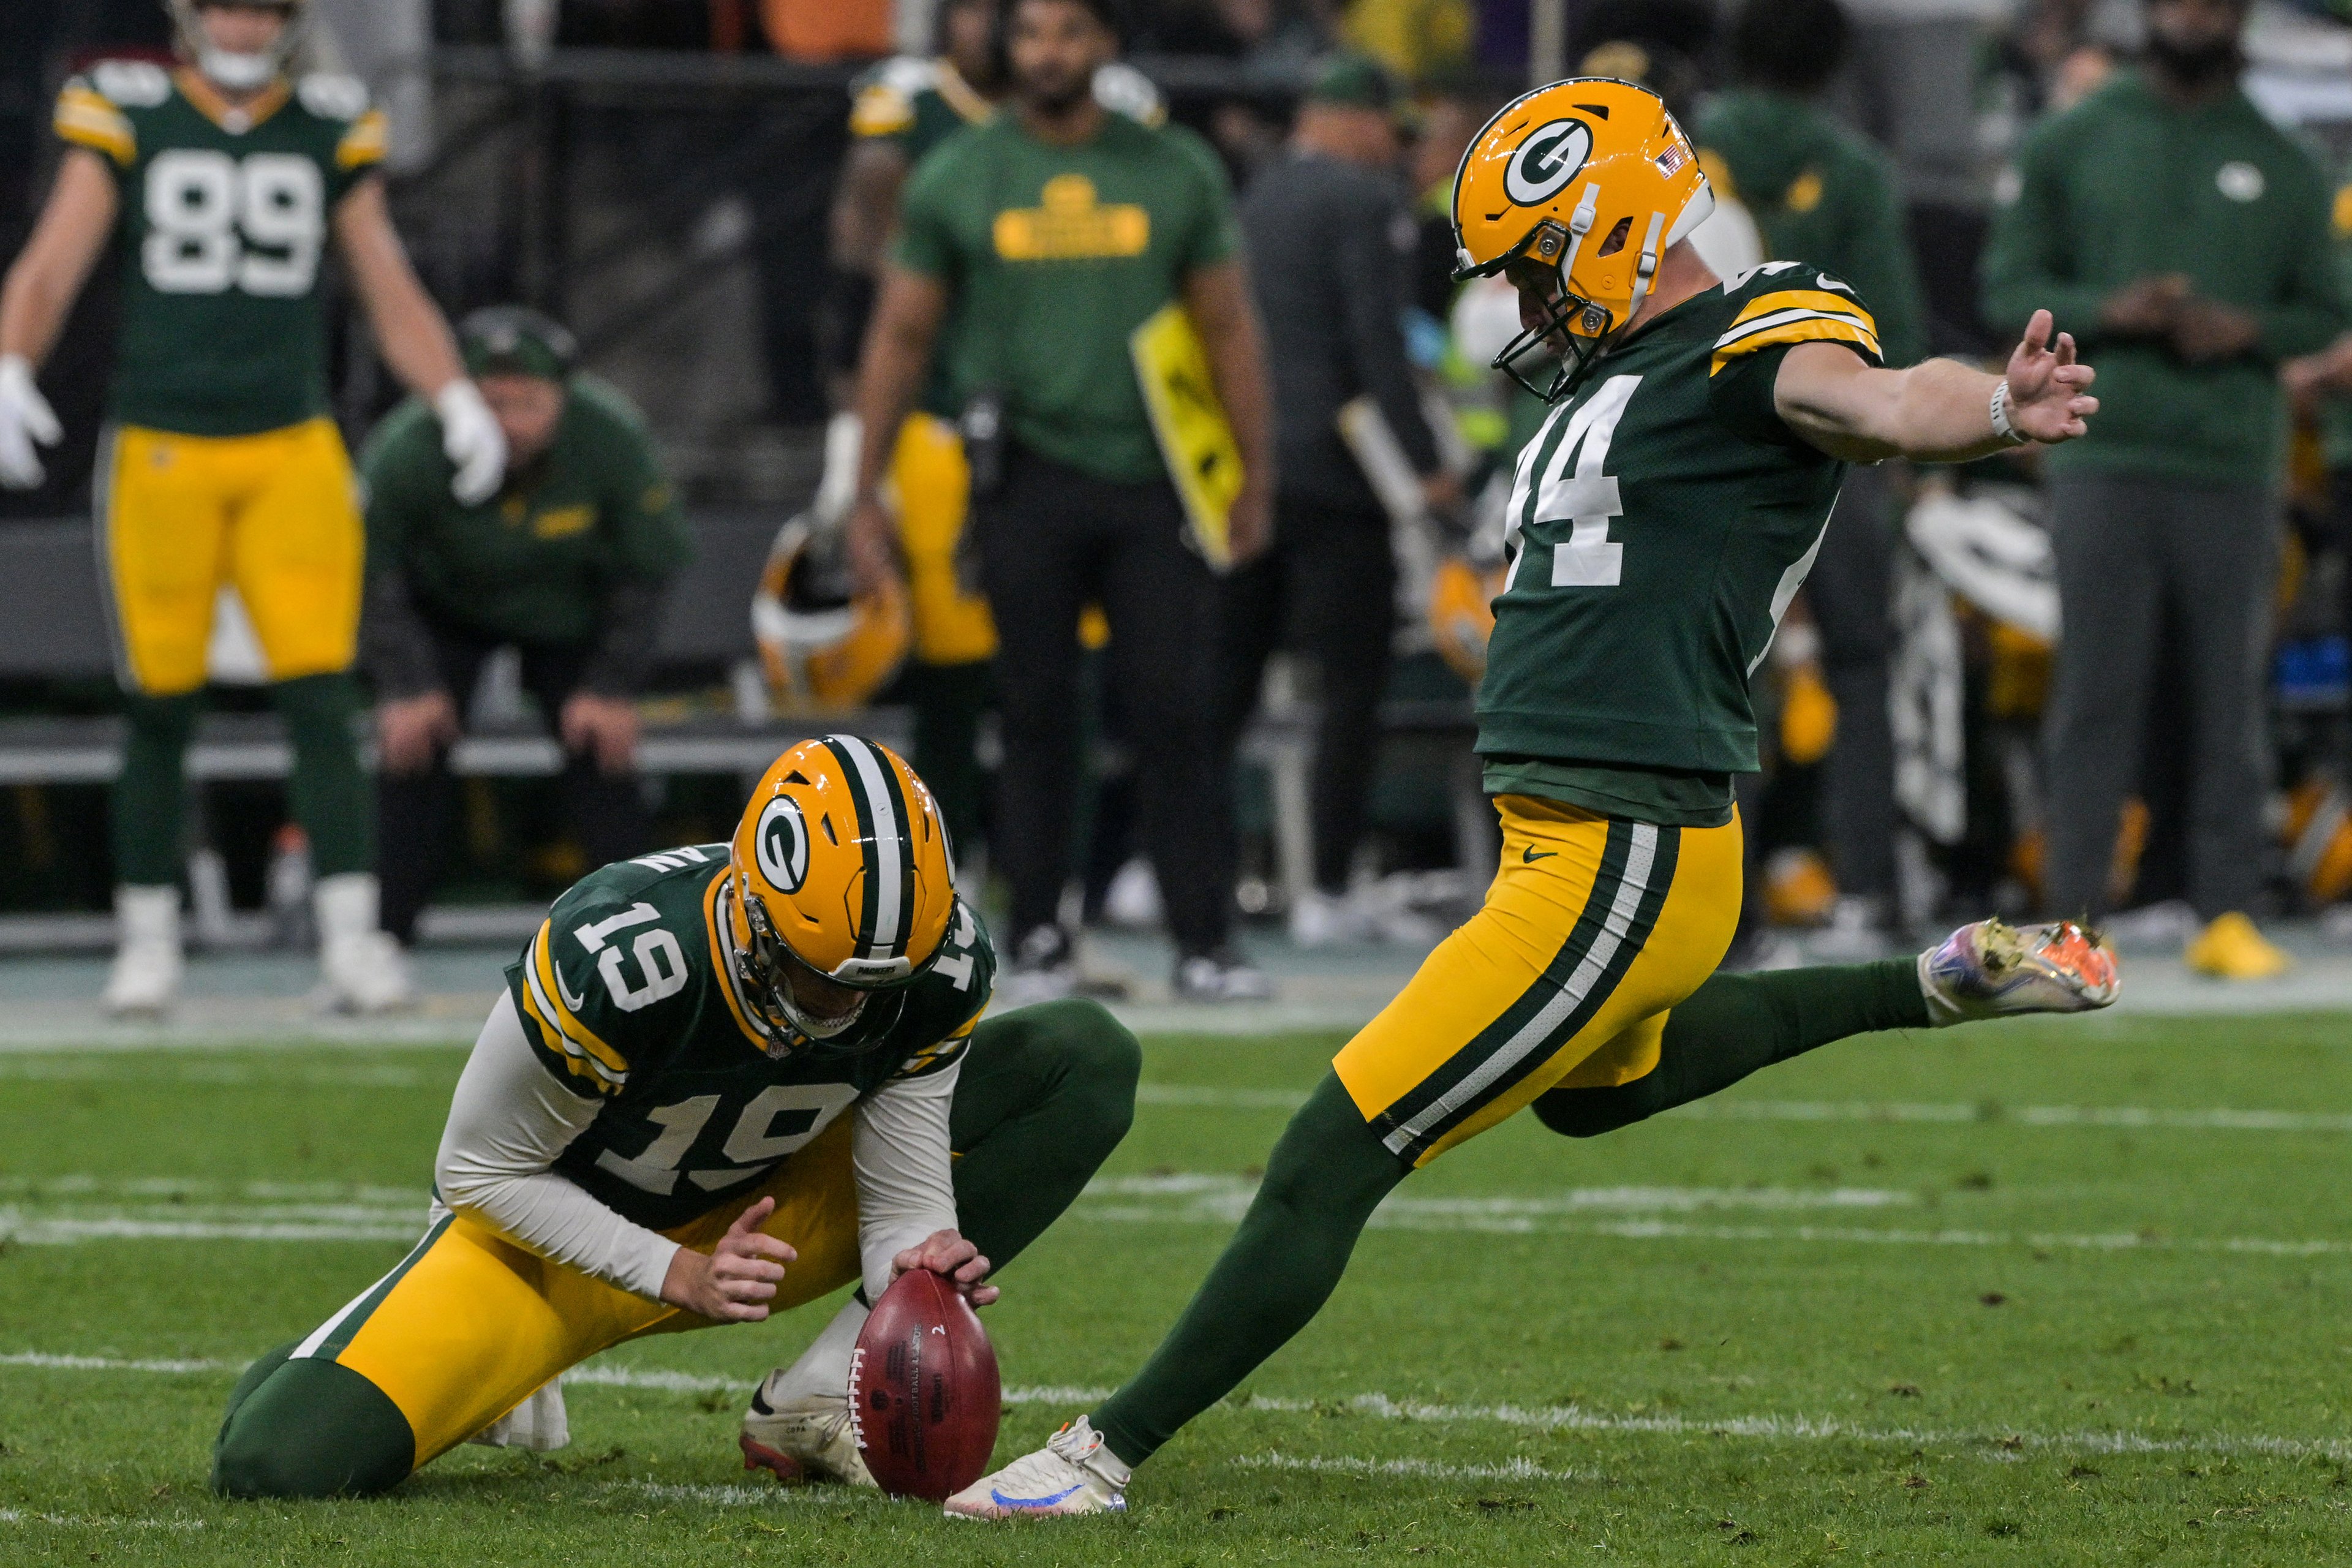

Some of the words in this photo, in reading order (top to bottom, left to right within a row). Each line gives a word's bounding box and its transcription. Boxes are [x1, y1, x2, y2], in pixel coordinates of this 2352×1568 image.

[143, 149, 326, 298] 89
[573, 902, 689, 1013] 19
[856, 966, 896, 974] PACKERS
[595, 1083, 861, 1196] 19
[932, 1324, 946, 1335] 2
[911, 1368, 920, 1422] FOOTBALL
